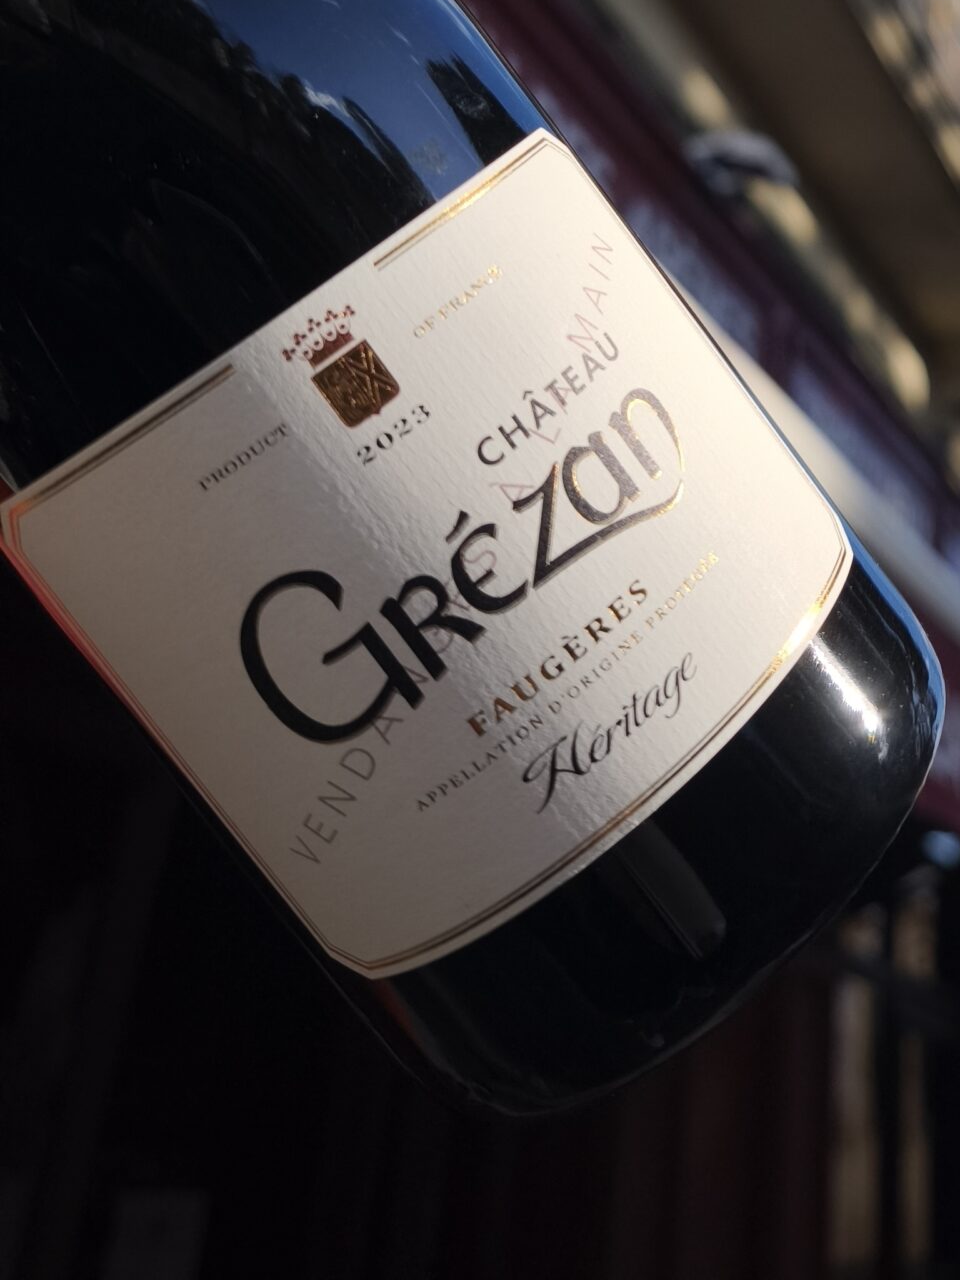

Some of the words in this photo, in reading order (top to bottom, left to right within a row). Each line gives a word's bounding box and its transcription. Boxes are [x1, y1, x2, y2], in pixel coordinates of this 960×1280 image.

[413, 317, 436, 339] OF
[566, 231, 614, 353] MAIN
[199, 422, 289, 492] PRODUCT
[356, 404, 431, 466] 2023
[477, 332, 620, 466] CHÂTEAU
[415, 715, 546, 812] APPELLATION
[547, 629, 644, 716] D'ORIGINE
[466, 579, 650, 737] FAUGÈRES
[521, 651, 698, 815] Héritage
